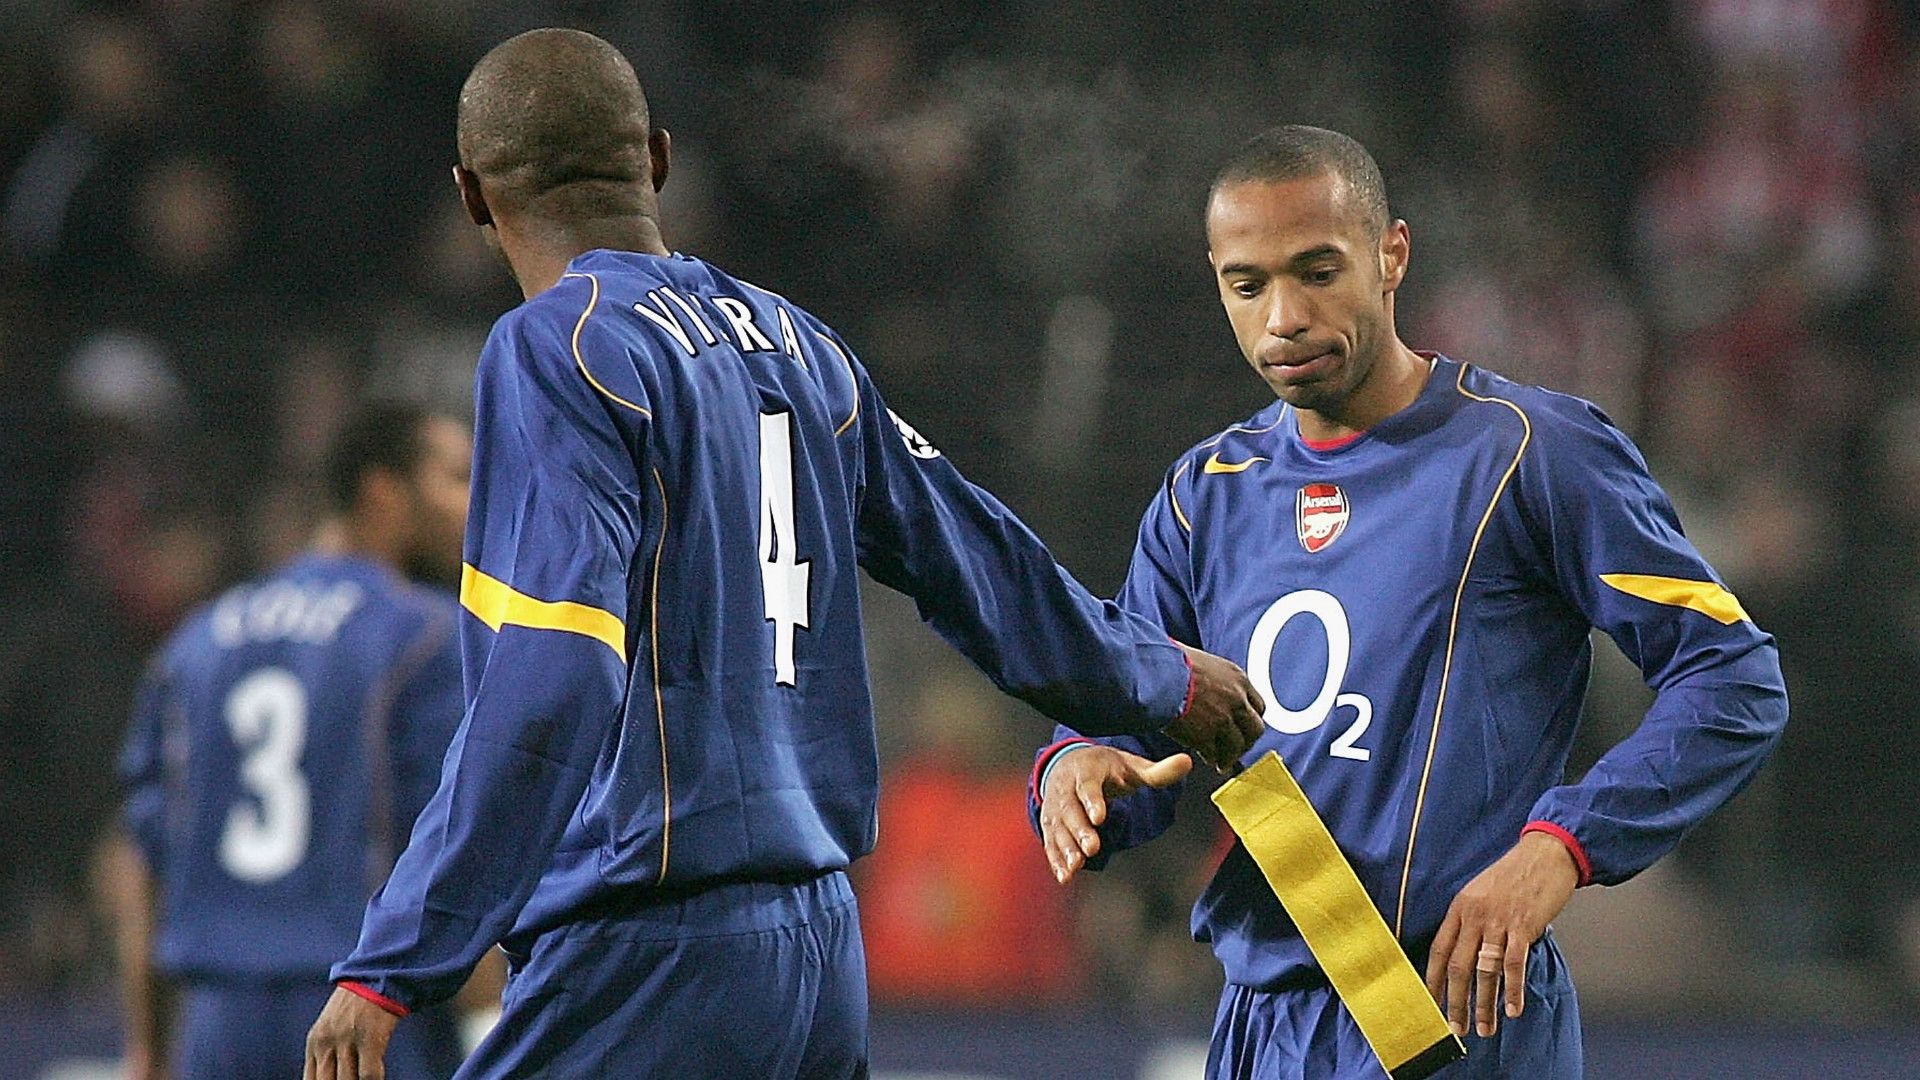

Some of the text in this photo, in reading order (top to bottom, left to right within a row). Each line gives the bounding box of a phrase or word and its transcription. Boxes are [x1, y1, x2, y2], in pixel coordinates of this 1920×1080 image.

[758, 412, 809, 686] 4
[223, 669, 311, 880] 3
[1247, 589, 1373, 761] O2
